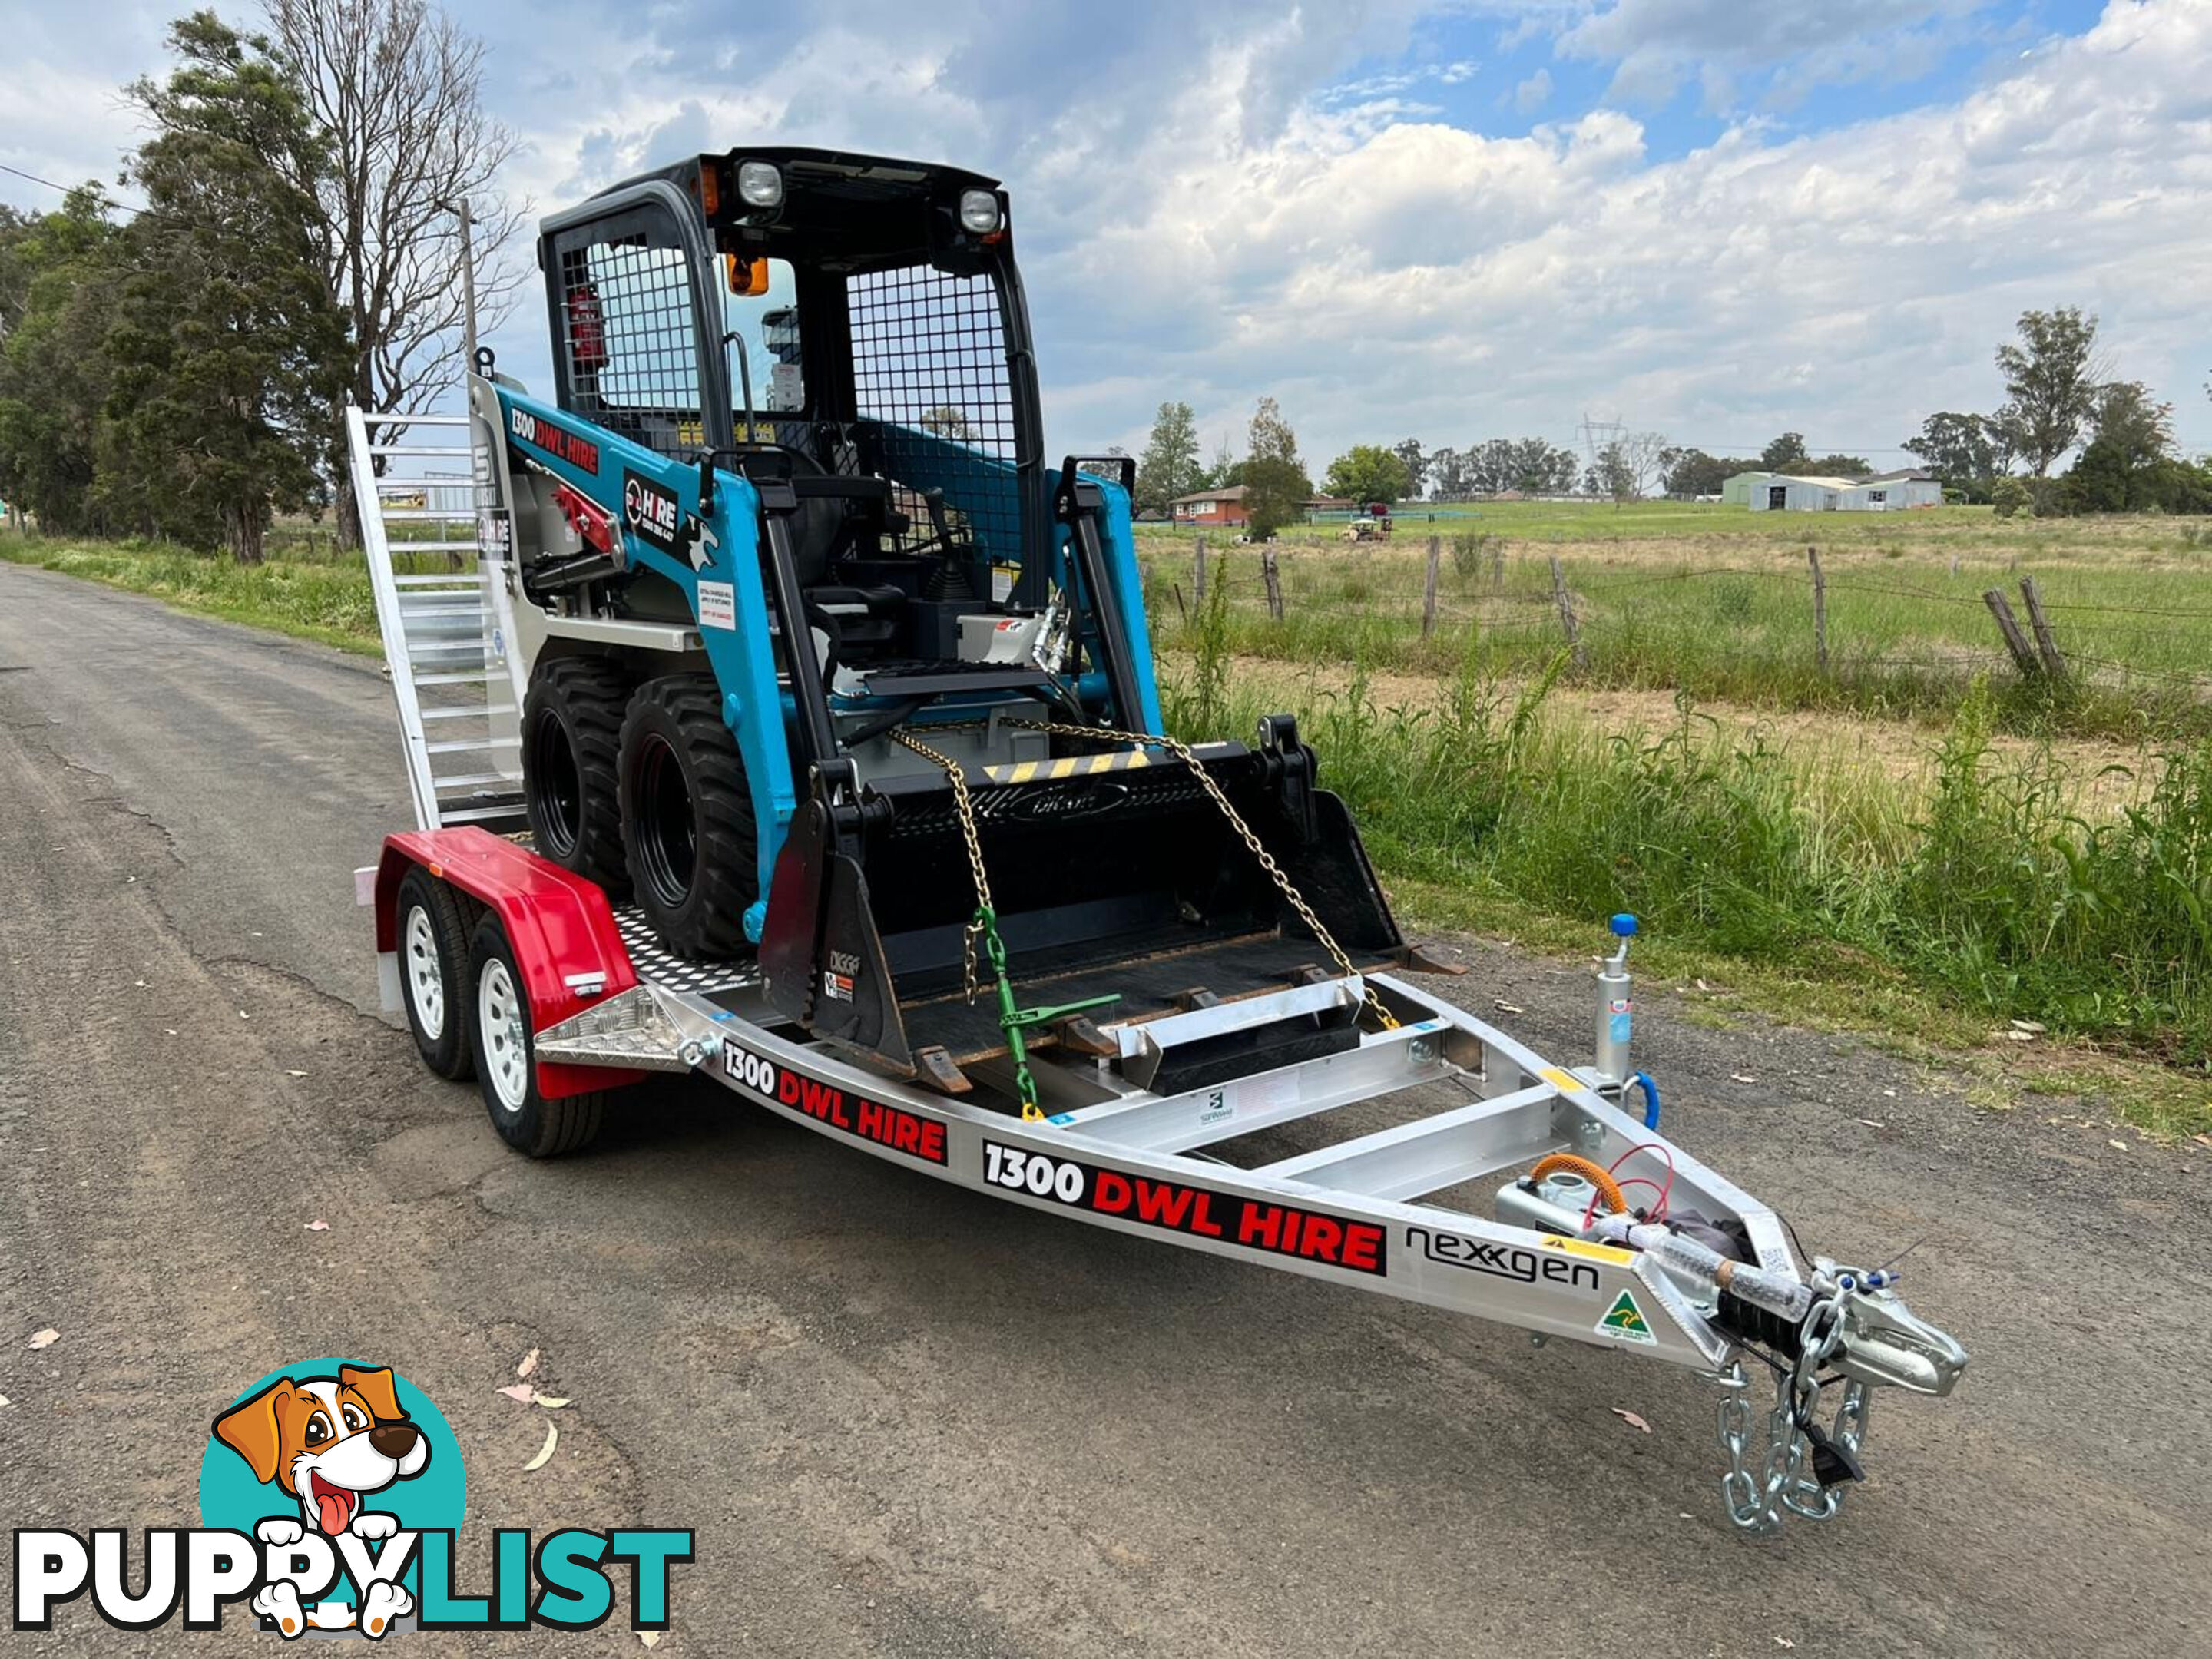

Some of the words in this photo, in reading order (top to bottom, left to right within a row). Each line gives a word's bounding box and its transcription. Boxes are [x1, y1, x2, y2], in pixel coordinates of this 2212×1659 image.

[512, 408, 535, 441] 1300
[536, 419, 565, 457] DWL
[568, 435, 598, 474] HIRE
[643, 488, 677, 531] HIRE
[724, 1044, 774, 1094] 1300
[779, 1068, 849, 1129] DWL
[858, 1099, 945, 1161] HIRE
[985, 1144, 1084, 1203] 1300
[1093, 1172, 1222, 1236] DWL
[1239, 1203, 1382, 1270] HIRE
[1406, 1227, 1598, 1290] nexxgen
